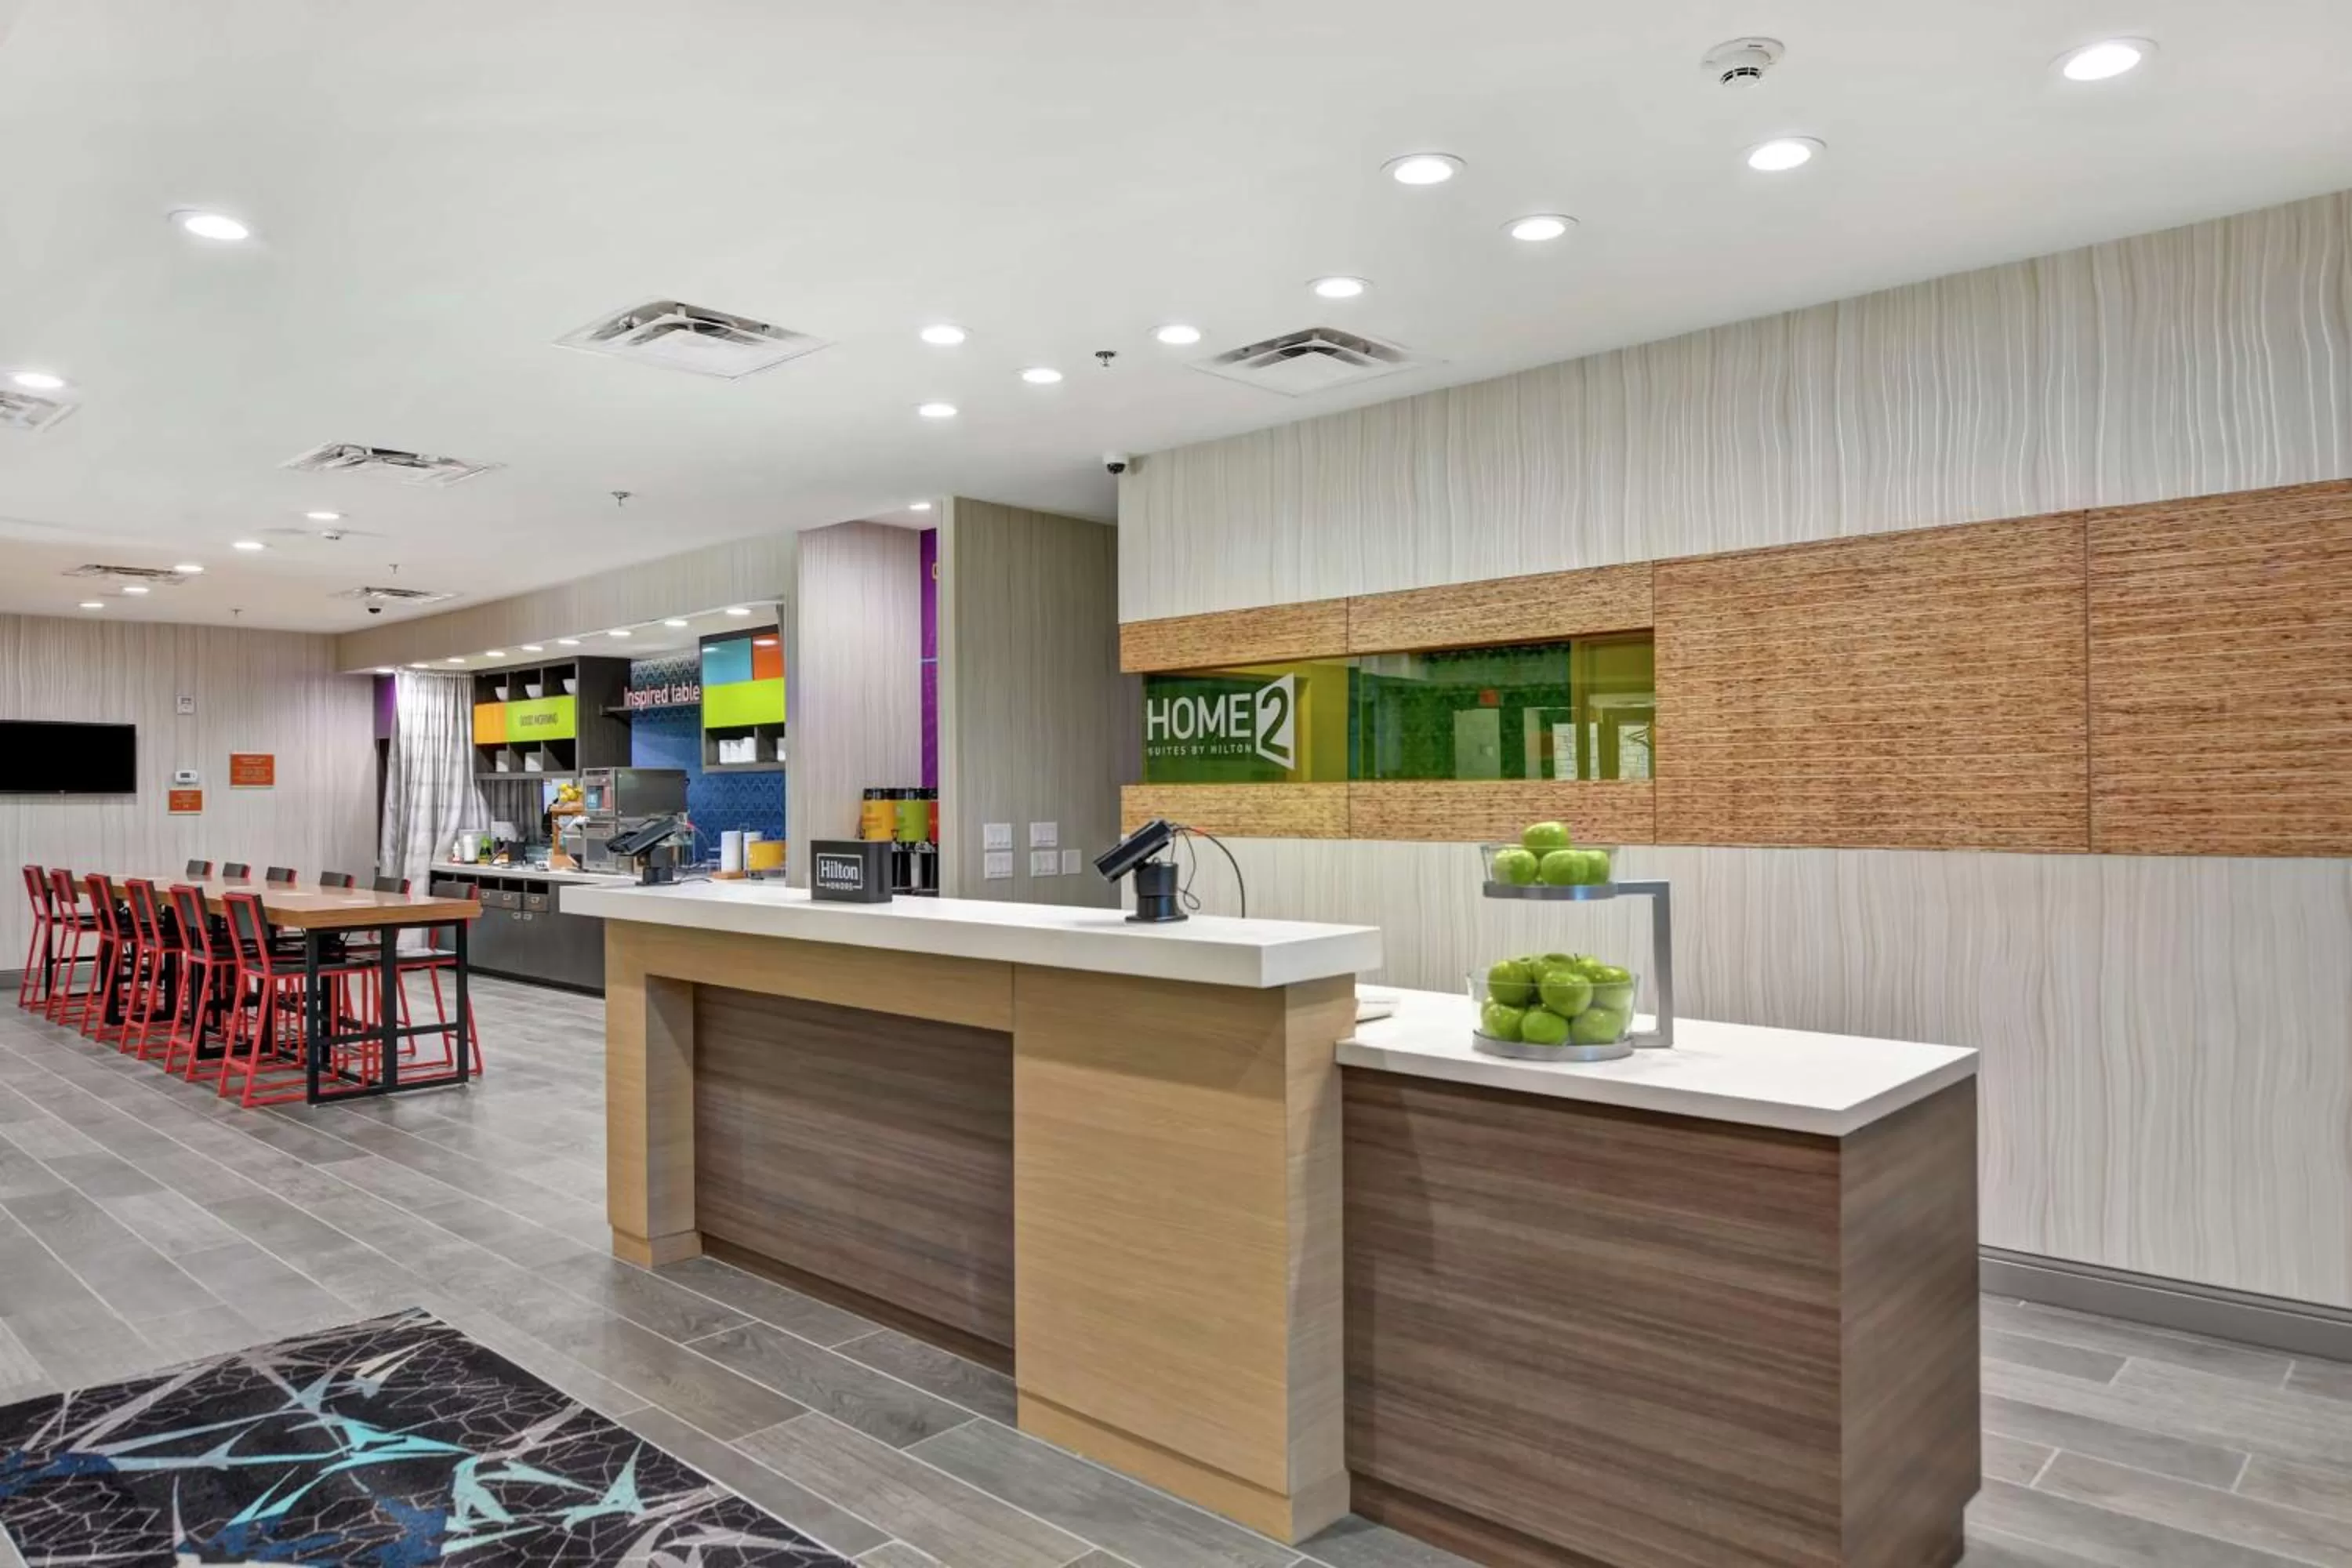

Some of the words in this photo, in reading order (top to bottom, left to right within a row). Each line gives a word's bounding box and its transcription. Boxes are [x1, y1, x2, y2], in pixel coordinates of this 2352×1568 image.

[624, 683, 669, 711] Inspired
[671, 680, 700, 703] table
[1147, 693, 1252, 741] HOME
[1148, 746, 1186, 757] SUITES
[1192, 746, 1205, 755] BY
[1210, 743, 1252, 754] HILTON
[820, 859, 858, 880] Hilton
